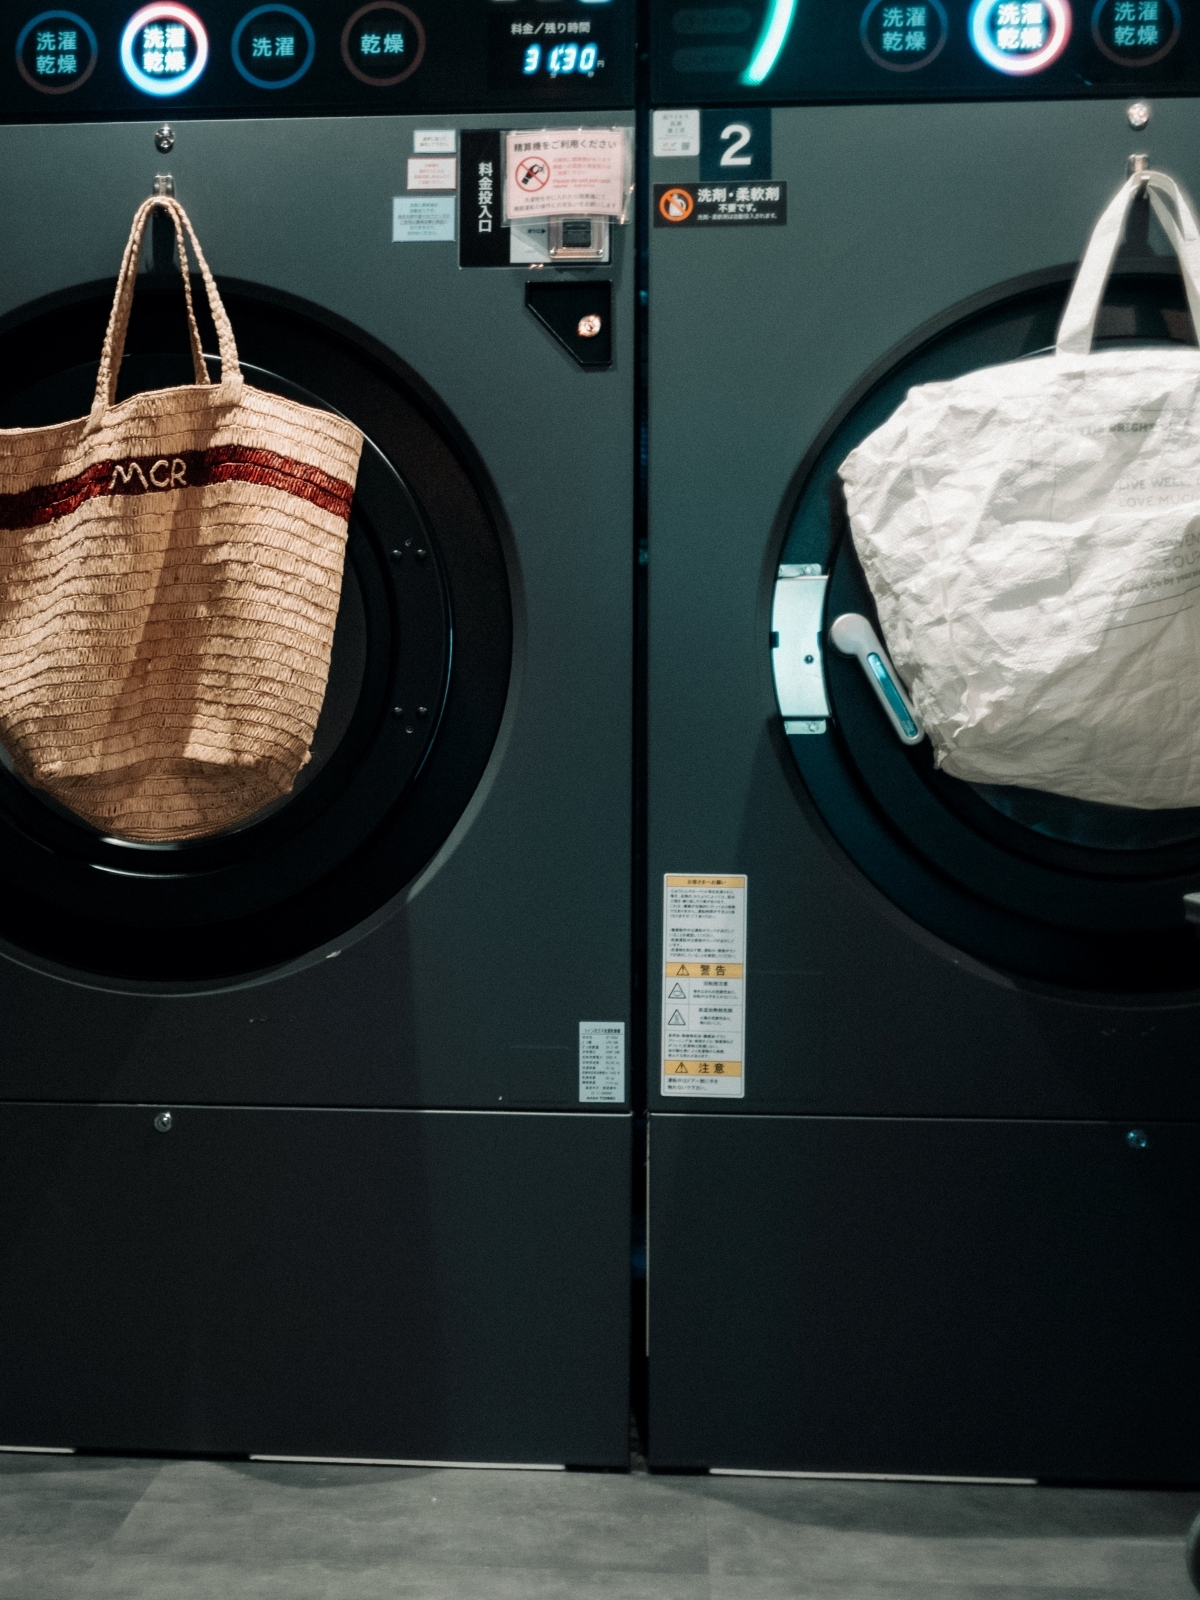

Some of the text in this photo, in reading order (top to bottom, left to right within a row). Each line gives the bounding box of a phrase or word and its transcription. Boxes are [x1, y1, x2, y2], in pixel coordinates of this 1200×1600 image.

[883, 8, 926, 28] 洗濯
[998, 3, 1042, 25] 洗濯
[1114, 2, 1159, 22] 洗濯
[36, 31, 77, 51] 洗濯
[143, 27, 185, 50] 洗濯
[361, 34, 404, 55] 乾燥
[883, 32, 926, 52] 乾燥
[998, 27, 1042, 49] 乾燥
[1114, 26, 1159, 46] 乾燥
[252, 37, 295, 58] 洗濯
[36, 55, 77, 75] 乾燥
[143, 51, 185, 73] 乾燥
[720, 124, 752, 166] 2
[478, 162, 493, 233] 料金投入口
[697, 186, 780, 203] 洗剤・柔軟剤
[718, 203, 757, 213] 不要です。
[108, 458, 187, 490] MCR
[700, 964, 726, 976] 警告
[698, 1062, 725, 1074] 注意
